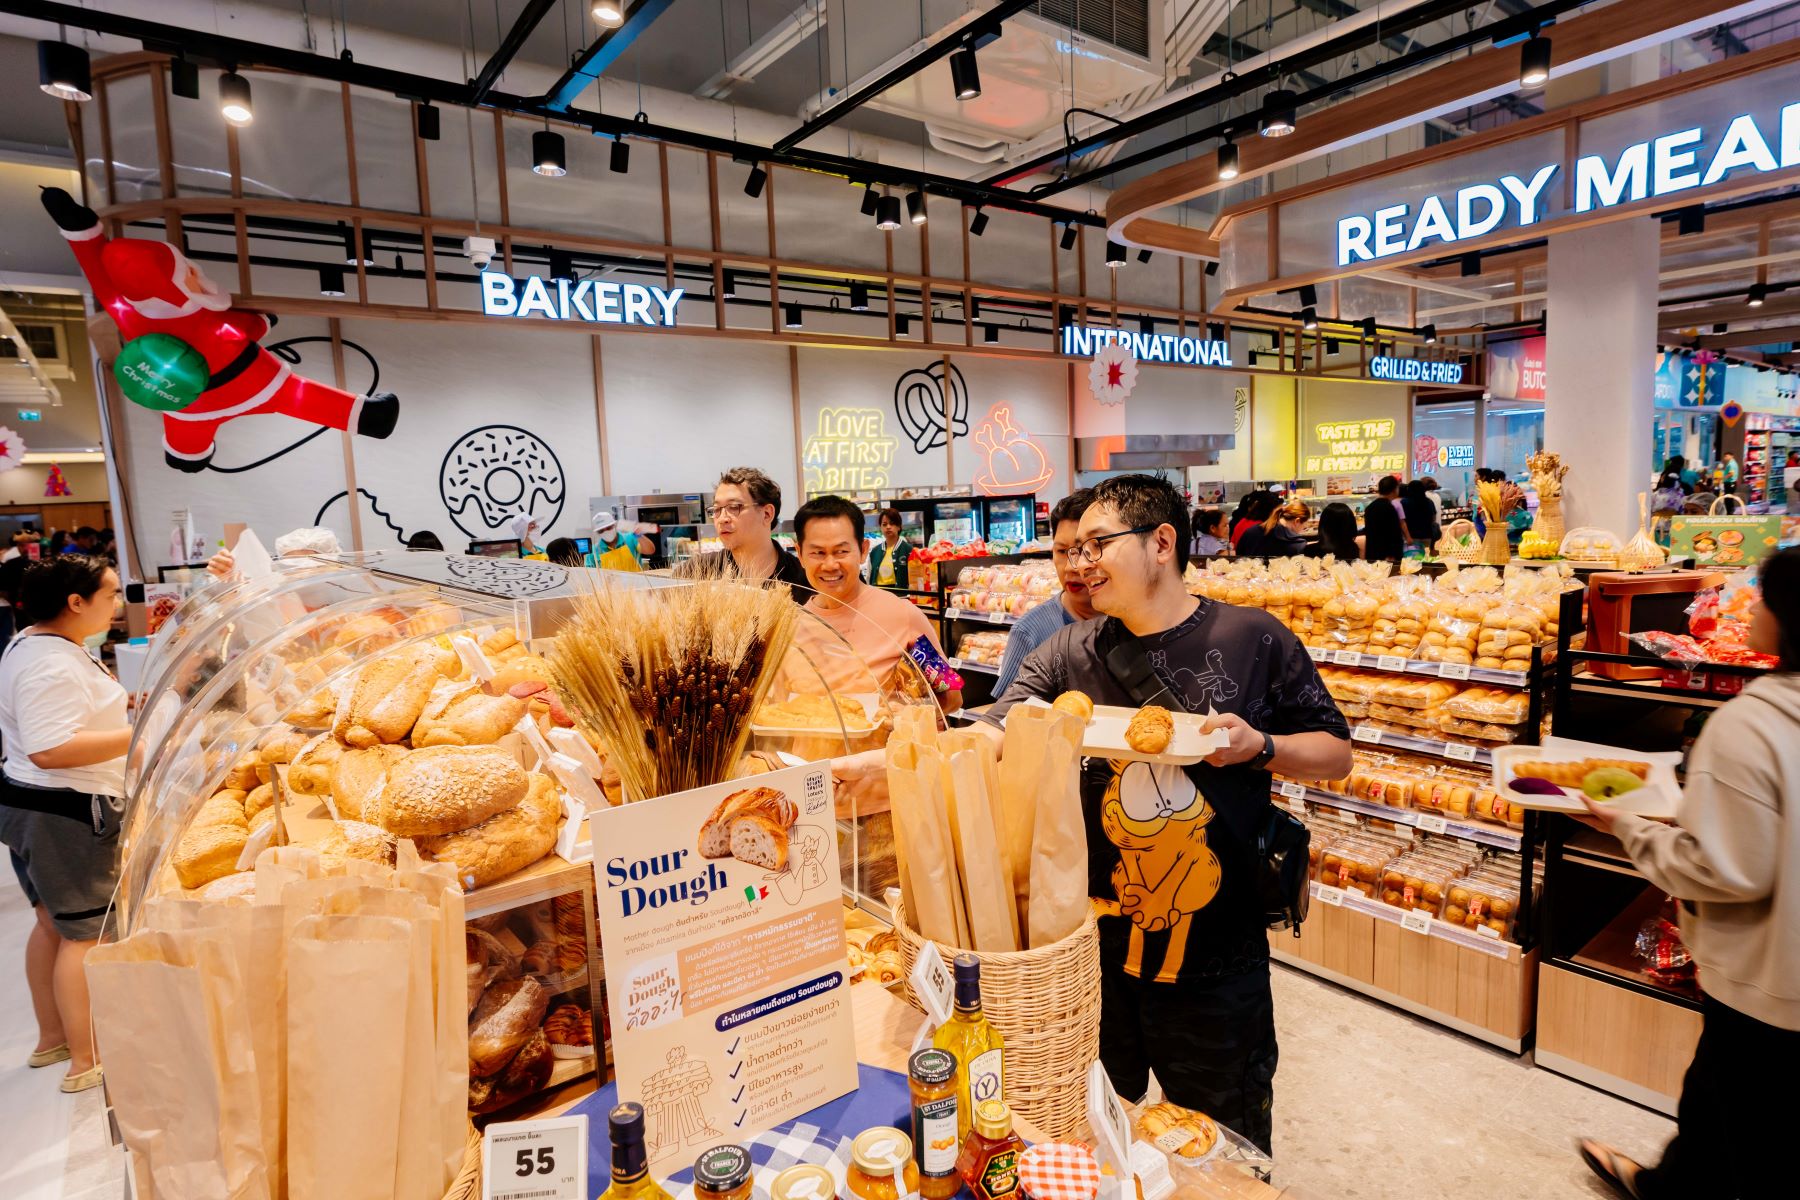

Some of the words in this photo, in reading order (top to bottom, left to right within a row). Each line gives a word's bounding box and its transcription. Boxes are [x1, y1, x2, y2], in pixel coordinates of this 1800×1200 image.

[1336, 162, 1561, 267] READY
[481, 272, 684, 326] BAKERY
[136, 362, 176, 388] Merry
[1371, 356, 1421, 380] GRILLED
[1422, 362, 1430, 381] &
[1431, 362, 1462, 383] FRIED
[122, 365, 181, 403] Christmas
[824, 415, 879, 438] LOVE
[1318, 424, 1360, 440] TASTE
[1362, 422, 1392, 438] THE
[808, 441, 832, 464] AT
[836, 441, 894, 464] FIRST
[1331, 440, 1378, 456] WORLD
[1306, 457, 1320, 472] IN
[1322, 456, 1368, 471] EVERY
[824, 468, 884, 489] BITE
[606, 847, 688, 888] Sour
[620, 862, 728, 918] Dough
[623, 929, 649, 943] Mother
[651, 921, 673, 936] dough
[710, 900, 744, 918] Sourdough
[629, 976, 676, 1007] Dough
[632, 968, 668, 990] Sour
[721, 990, 796, 1026] ทำไมหลายคนถึงชอบ
[798, 975, 838, 998] Sourdough
[744, 997, 839, 1044] ขนมปังขาวย่อยง่ายกว่า
[746, 1033, 802, 1068] น้ำตาลต่ำกว่า
[748, 1060, 803, 1094] มีใยอาหารสูง
[981, 1079, 990, 1096] Y
[780, 1086, 792, 1102] ต่ำ
[515, 1146, 556, 1177] 55
[709, 1146, 742, 1157] DALFOUR
[991, 1169, 1016, 1182] HONEY
